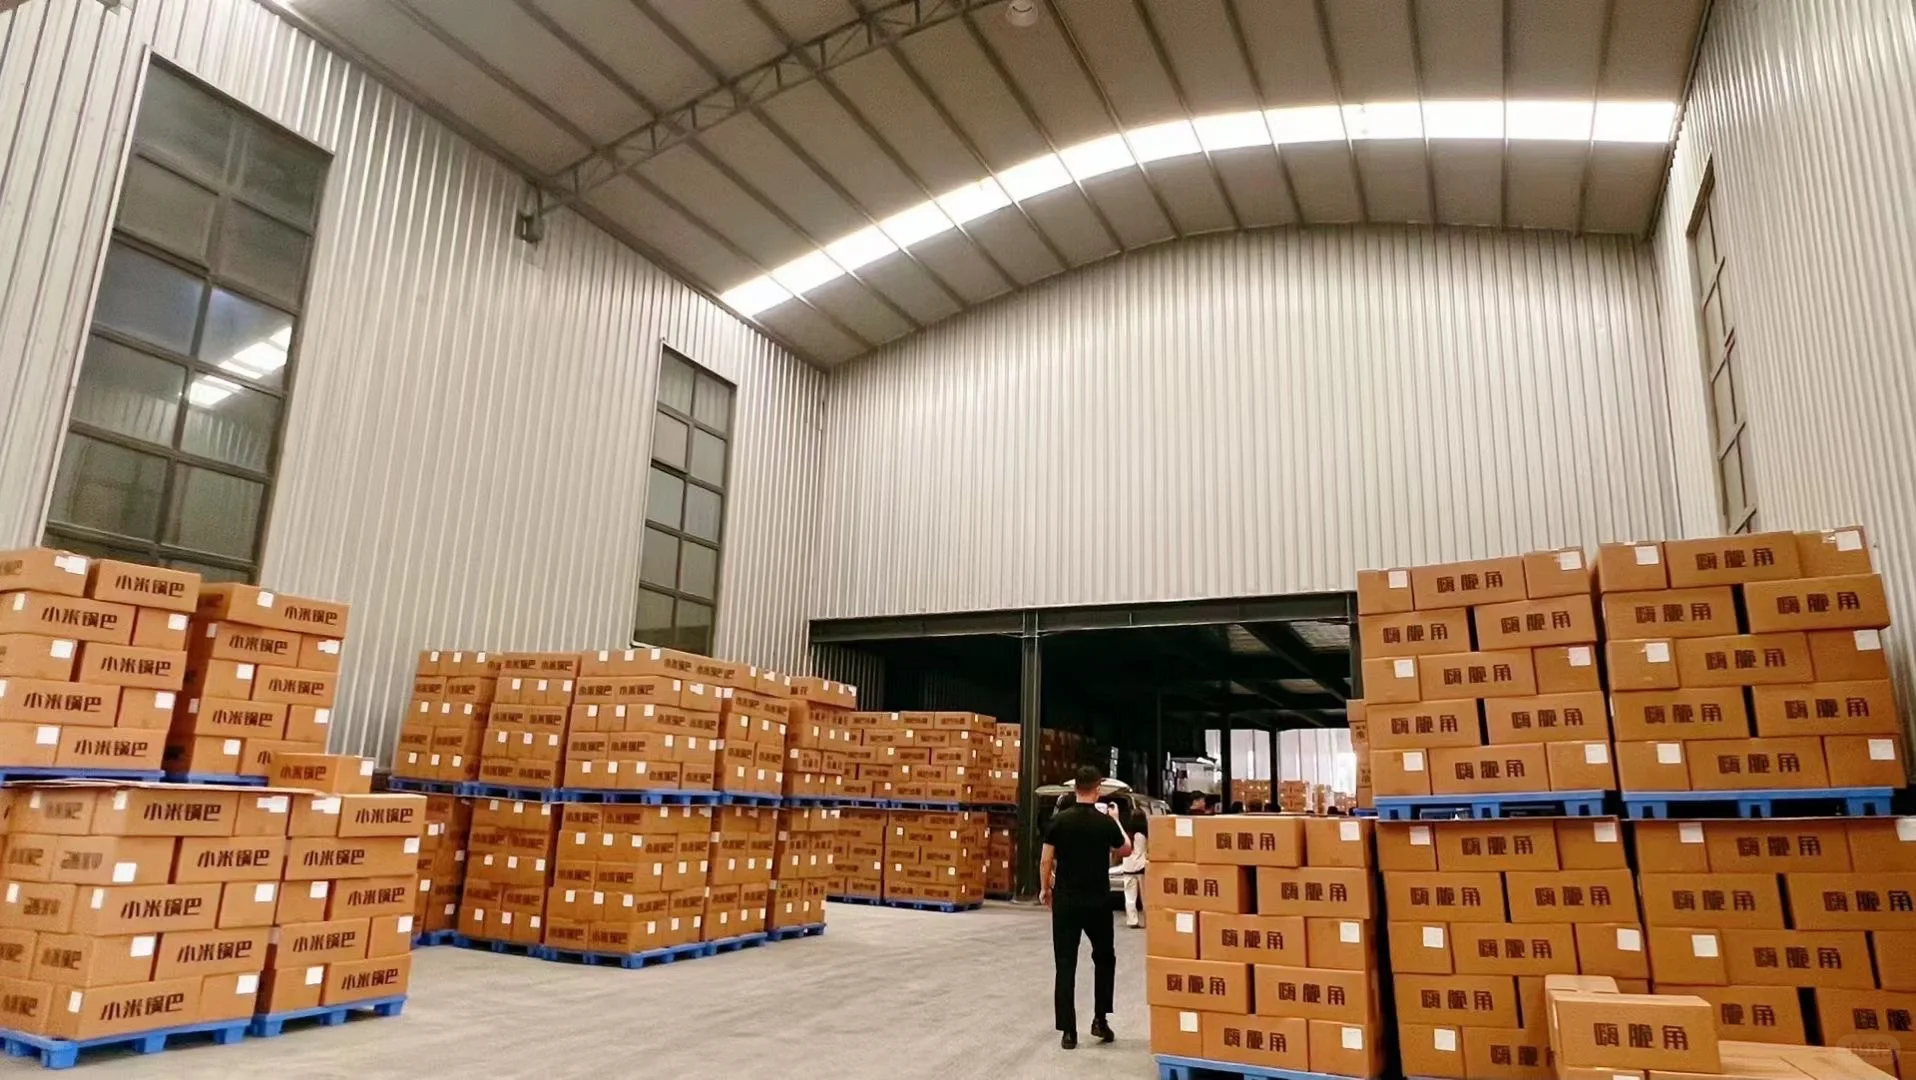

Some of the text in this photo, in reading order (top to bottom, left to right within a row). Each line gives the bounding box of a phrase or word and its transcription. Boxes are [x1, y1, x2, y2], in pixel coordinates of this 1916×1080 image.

[116, 575, 185, 598] 小米锅巴
[42, 606, 118, 631] 小米锅巴
[284, 606, 338, 626] 小米锅巴
[230, 634, 288, 654] 小米锅巴
[101, 656, 171, 677] 小米锅巴
[269, 678, 324, 696] 小米锅巴
[24, 692, 102, 712] 小米锅巴
[212, 710, 273, 727] 小米锅巴
[74, 740, 148, 757] 小米锅巴
[280, 765, 326, 781] 小米锅巴
[144, 803, 221, 821] 小米锅巴
[356, 808, 413, 824] 小米锅巴
[198, 849, 270, 868] 小米锅巴
[304, 849, 365, 866] 小米锅巴
[348, 887, 405, 906] 小米锅巴
[120, 898, 202, 919] 小米锅巴
[177, 940, 252, 962] 小米锅巴
[293, 932, 356, 952] 小米锅巴
[342, 969, 398, 990] 小米锅巴
[100, 993, 184, 1020] 小米锅巴
[1721, 1004, 1776, 1026] 脆角
[1853, 1008, 1913, 1031] 嗨脆
[1594, 1023, 1688, 1050] 嗨脆角
